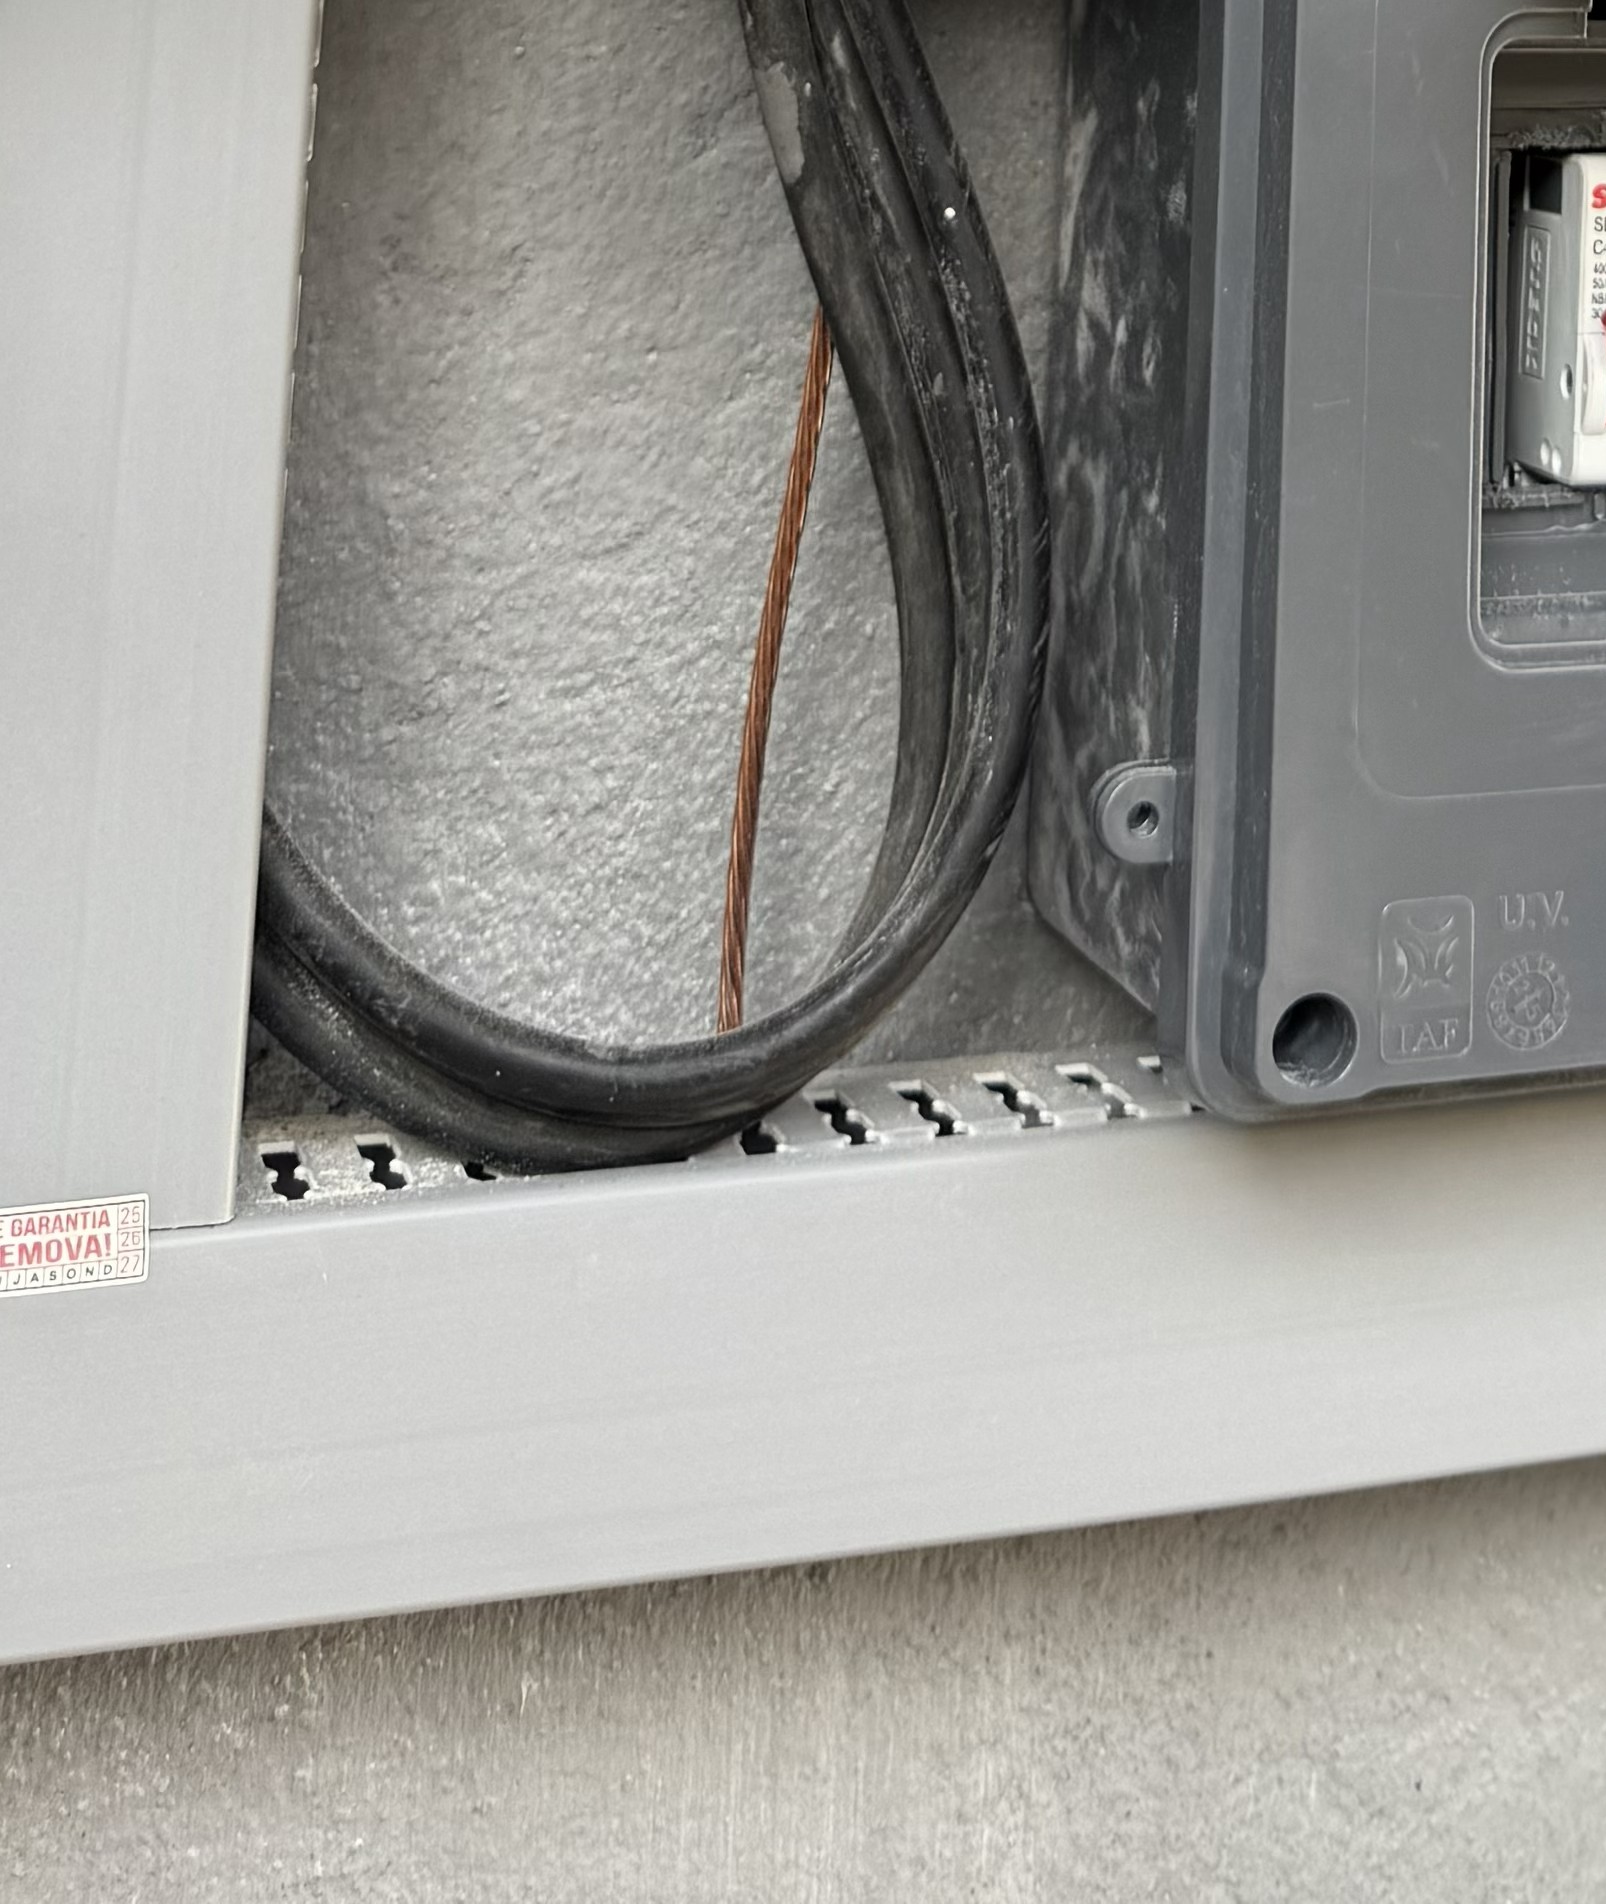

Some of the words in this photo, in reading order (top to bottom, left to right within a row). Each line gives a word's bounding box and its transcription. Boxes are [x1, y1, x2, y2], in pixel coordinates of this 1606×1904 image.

[1499, 890, 1570, 932] U.V.
[11, 1209, 110, 1237] GARANTIA
[121, 1206, 141, 1225] 25
[121, 1230, 141, 1247] 26
[0, 1233, 111, 1268] EMOVA!
[30, 1273, 39, 1282] A
[49, 1271, 57, 1281] S
[67, 1268, 76, 1278] O
[86, 1266, 95, 1276] N
[103, 1265, 113, 1275] D
[120, 1254, 140, 1274] 27
